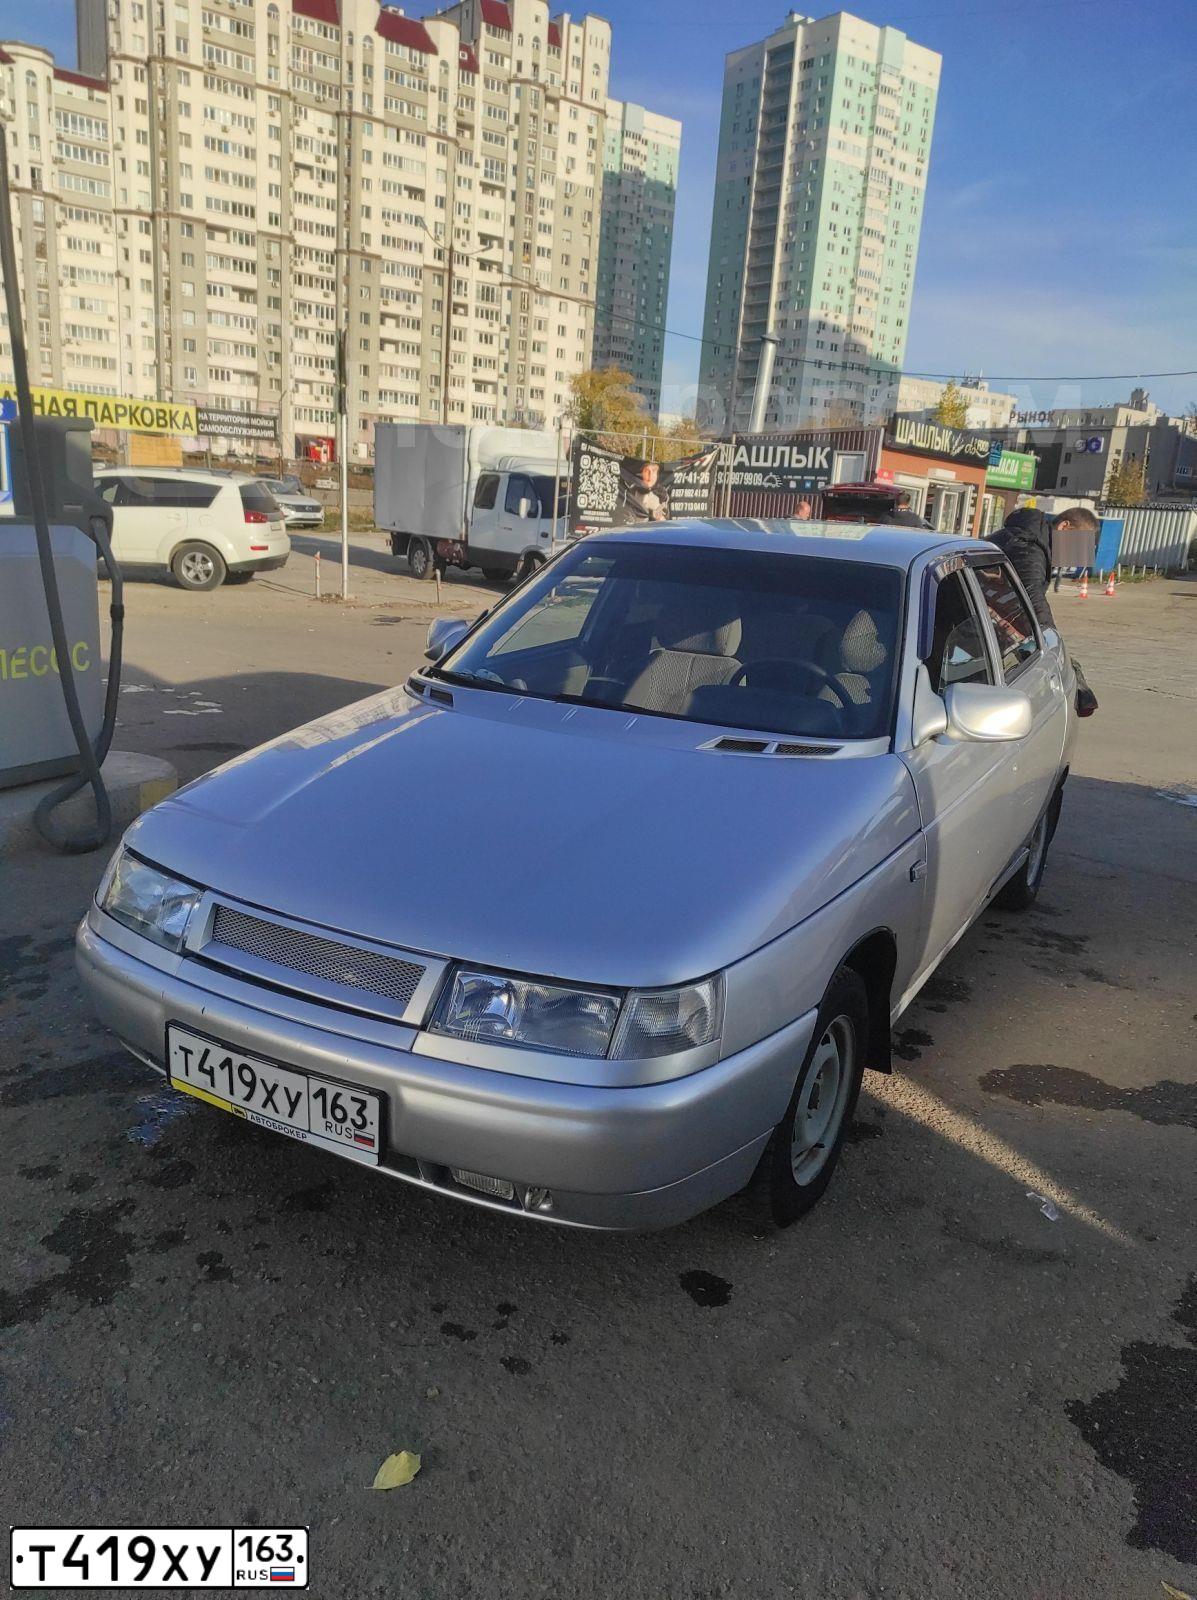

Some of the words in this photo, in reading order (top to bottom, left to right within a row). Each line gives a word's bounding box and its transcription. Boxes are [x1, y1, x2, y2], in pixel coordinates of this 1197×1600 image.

[4, 389, 77, 417] НАЯ
[85, 400, 194, 431] ПАРКОВКА
[198, 412, 208, 421] НА
[208, 412, 250, 425] ТЕРРИТОРИИ
[250, 417, 275, 427] МОЙКИ
[1009, 410, 1056, 424] РЫНОК
[198, 422, 275, 438] САМООБСЛУЖИВАНИЯ
[895, 417, 953, 453] ШАШЛЫК
[717, 445, 831, 469] ШАШЛЫК
[178, 1045, 302, 1118] Т419ХУ
[312, 1087, 368, 1130] 163
[250, 1114, 308, 1139] АВТОБРОКЕР
[325, 1121, 353, 1139] RUS
